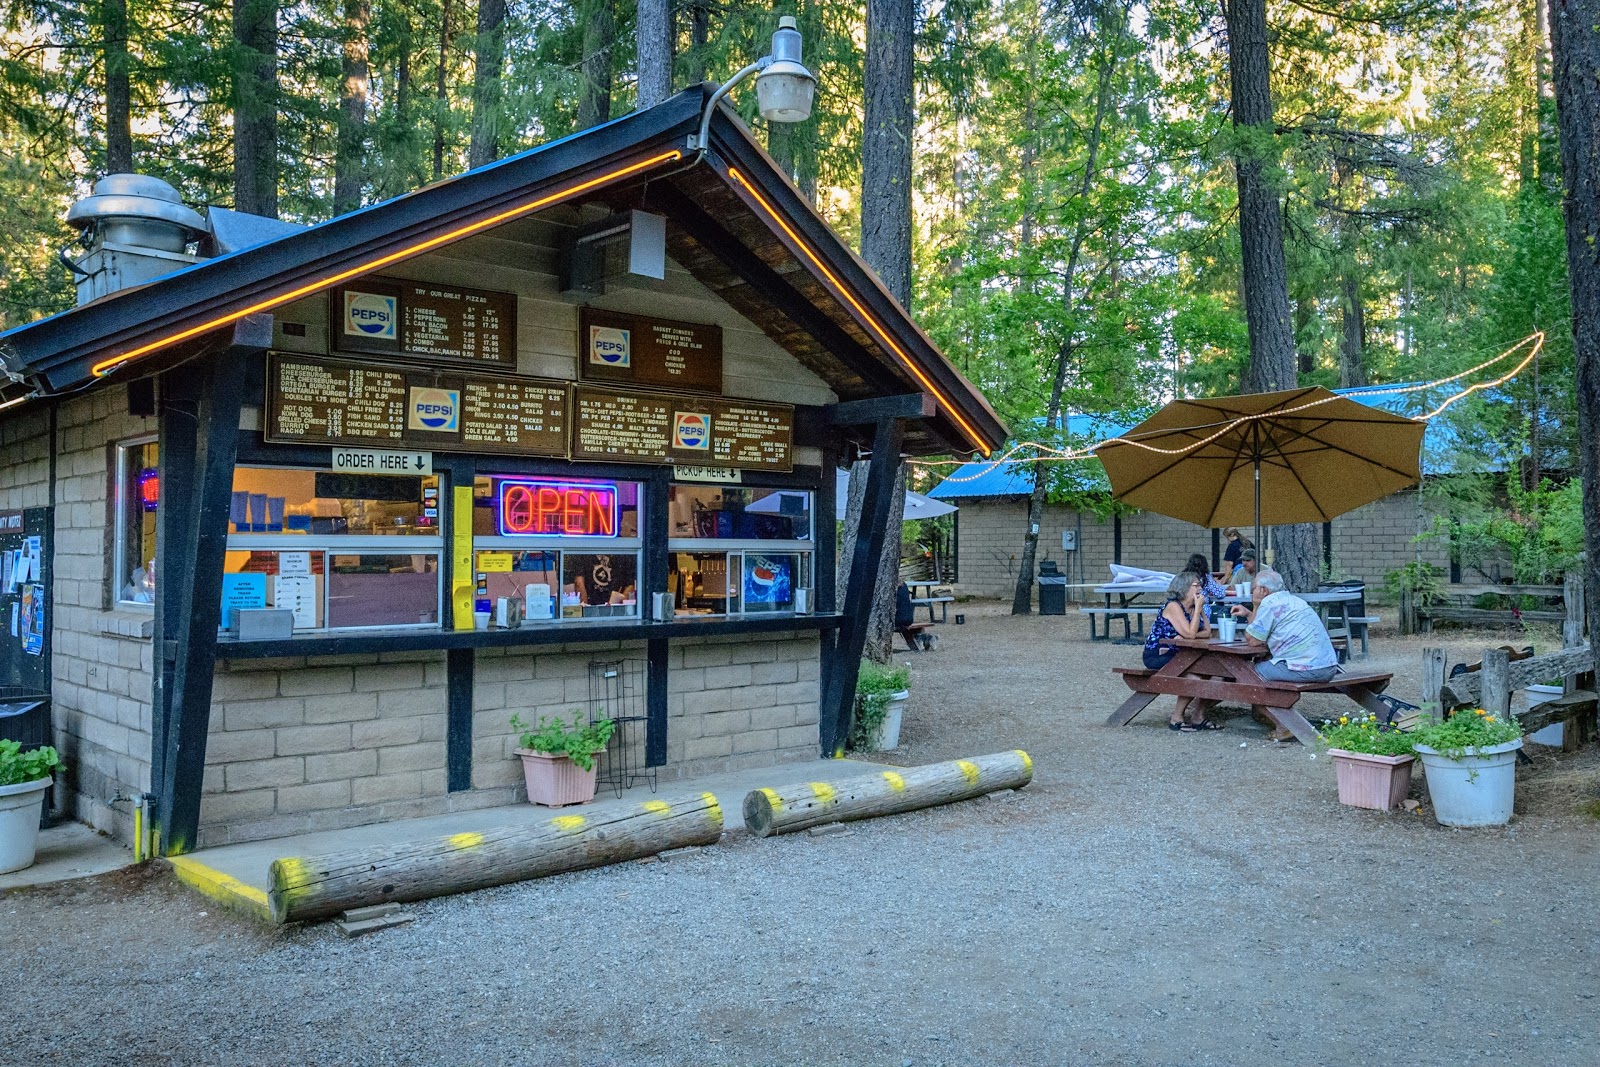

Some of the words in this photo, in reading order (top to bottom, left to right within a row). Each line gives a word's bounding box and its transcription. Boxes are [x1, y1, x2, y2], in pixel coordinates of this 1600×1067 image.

[352, 308, 389, 322] PEPSI
[414, 314, 447, 323] PEPPERONI
[414, 332, 449, 341] VEGETARIAN
[596, 341, 625, 352] PEPSI
[281, 363, 323, 372] HAMBURGER
[281, 369, 332, 379] CHEESEBURGER
[298, 376, 346, 386] CHEESEBURGER
[416, 403, 452, 415] PEPSI
[679, 426, 705, 436] PEPSI
[338, 453, 374, 468] ORDER
[381, 455, 408, 469] HERE
[676, 466, 702, 476] PICKUP
[707, 468, 726, 477] HERE
[505, 486, 613, 535] OPEN
